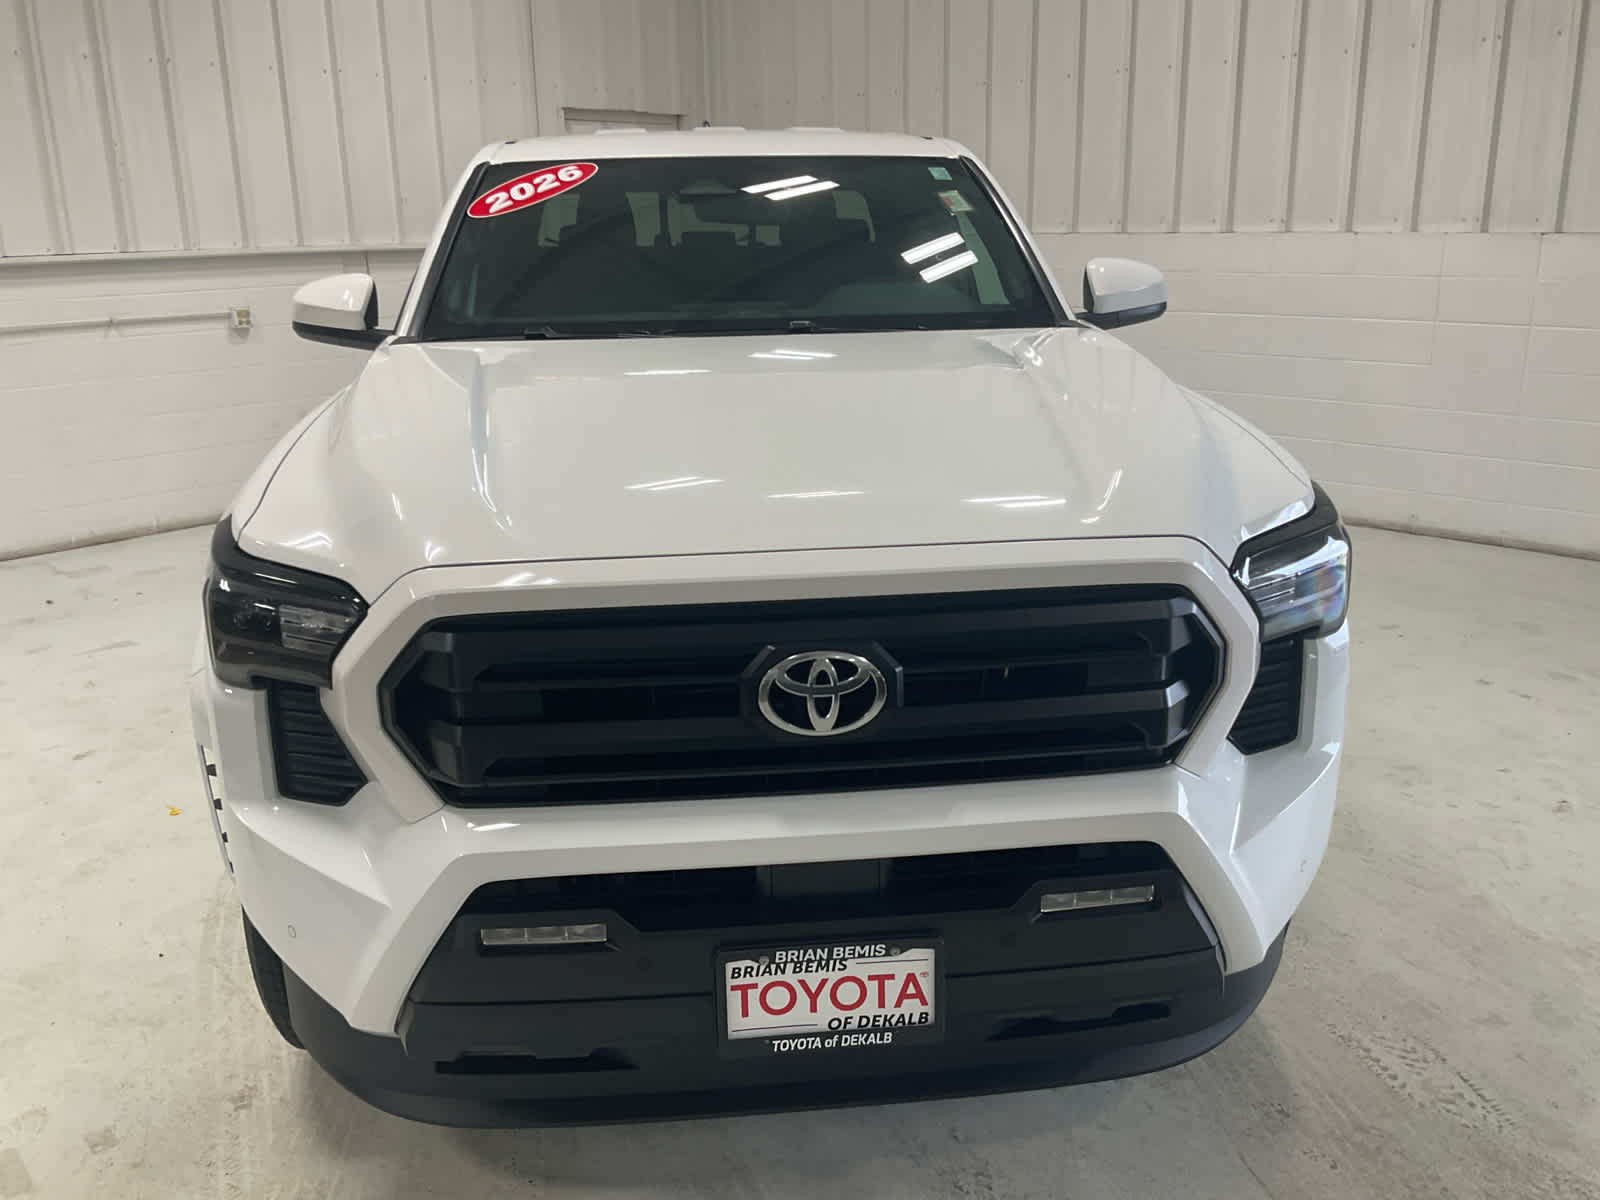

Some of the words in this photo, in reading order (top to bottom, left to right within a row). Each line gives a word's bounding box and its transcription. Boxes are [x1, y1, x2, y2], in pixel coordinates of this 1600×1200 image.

[485, 165, 583, 213] 2026
[775, 947, 828, 963] BRIAN
[833, 944, 886, 959] BEMIS
[730, 963, 787, 980] BRIAN
[792, 959, 848, 974] BEMIS
[730, 972, 929, 1018] TOYOTA
[828, 1016, 853, 1031] OF
[857, 1012, 929, 1029] DEKALB
[772, 1037, 822, 1052] TOYOTA
[824, 1034, 840, 1048] of
[841, 1032, 893, 1047] DEKALB
